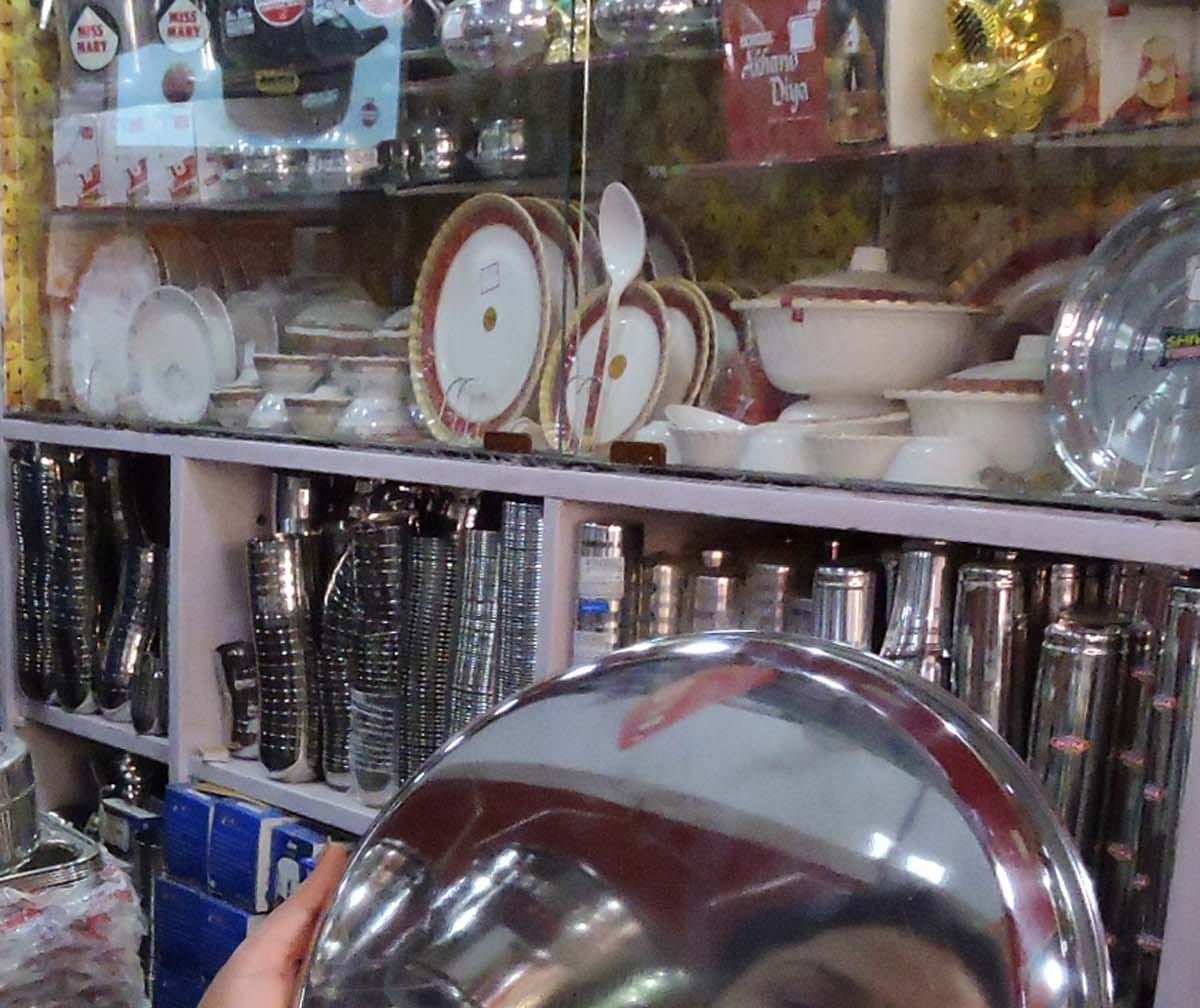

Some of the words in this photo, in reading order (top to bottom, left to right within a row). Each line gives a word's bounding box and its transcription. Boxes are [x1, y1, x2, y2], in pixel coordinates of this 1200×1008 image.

[77, 25, 104, 37] MISS
[166, 25, 200, 38] MARY
[76, 40, 107, 54] MARY
